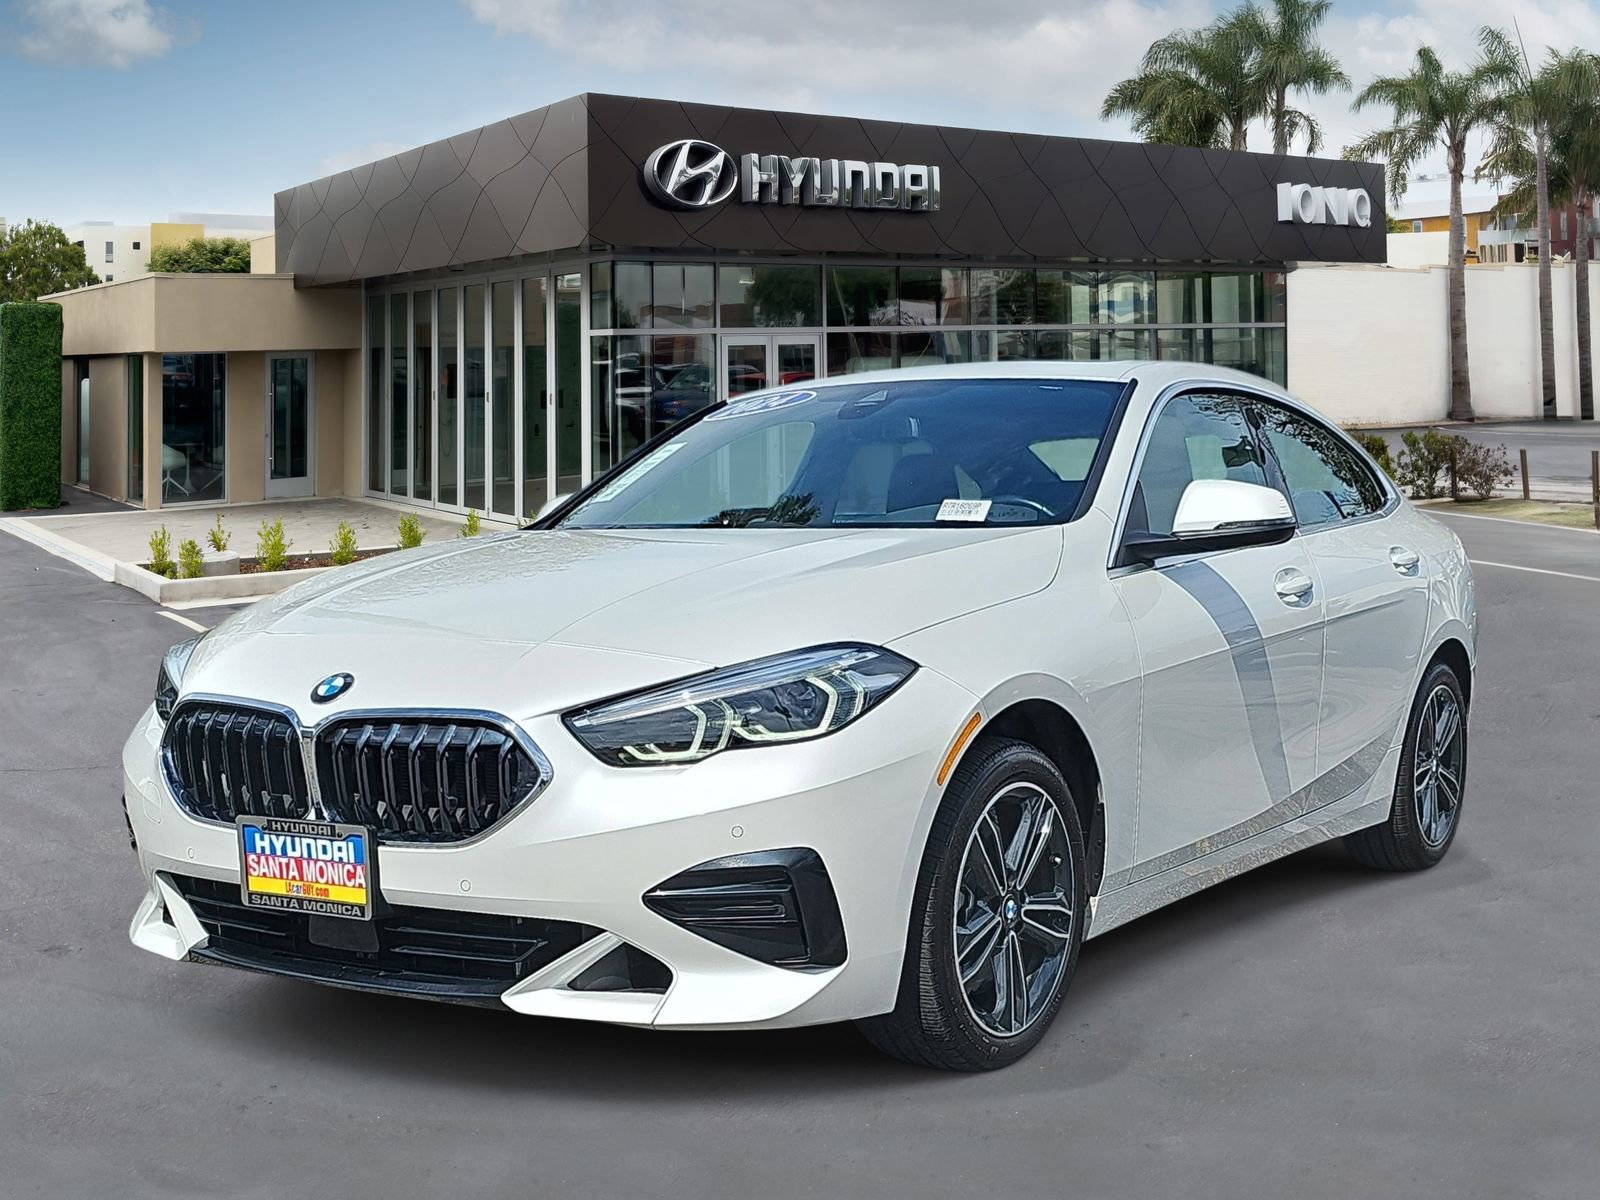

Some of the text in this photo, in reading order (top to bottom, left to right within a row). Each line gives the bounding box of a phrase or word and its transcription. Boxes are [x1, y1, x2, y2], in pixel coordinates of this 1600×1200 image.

[741, 152, 941, 212] HYUNDAI
[1276, 182, 1372, 228] IONIQ
[271, 820, 332, 836] HYUNDAI
[254, 832, 355, 864] HYUNDAI
[248, 854, 366, 888] SANTA MONICA
[251, 894, 362, 917] SANTA MONICA
